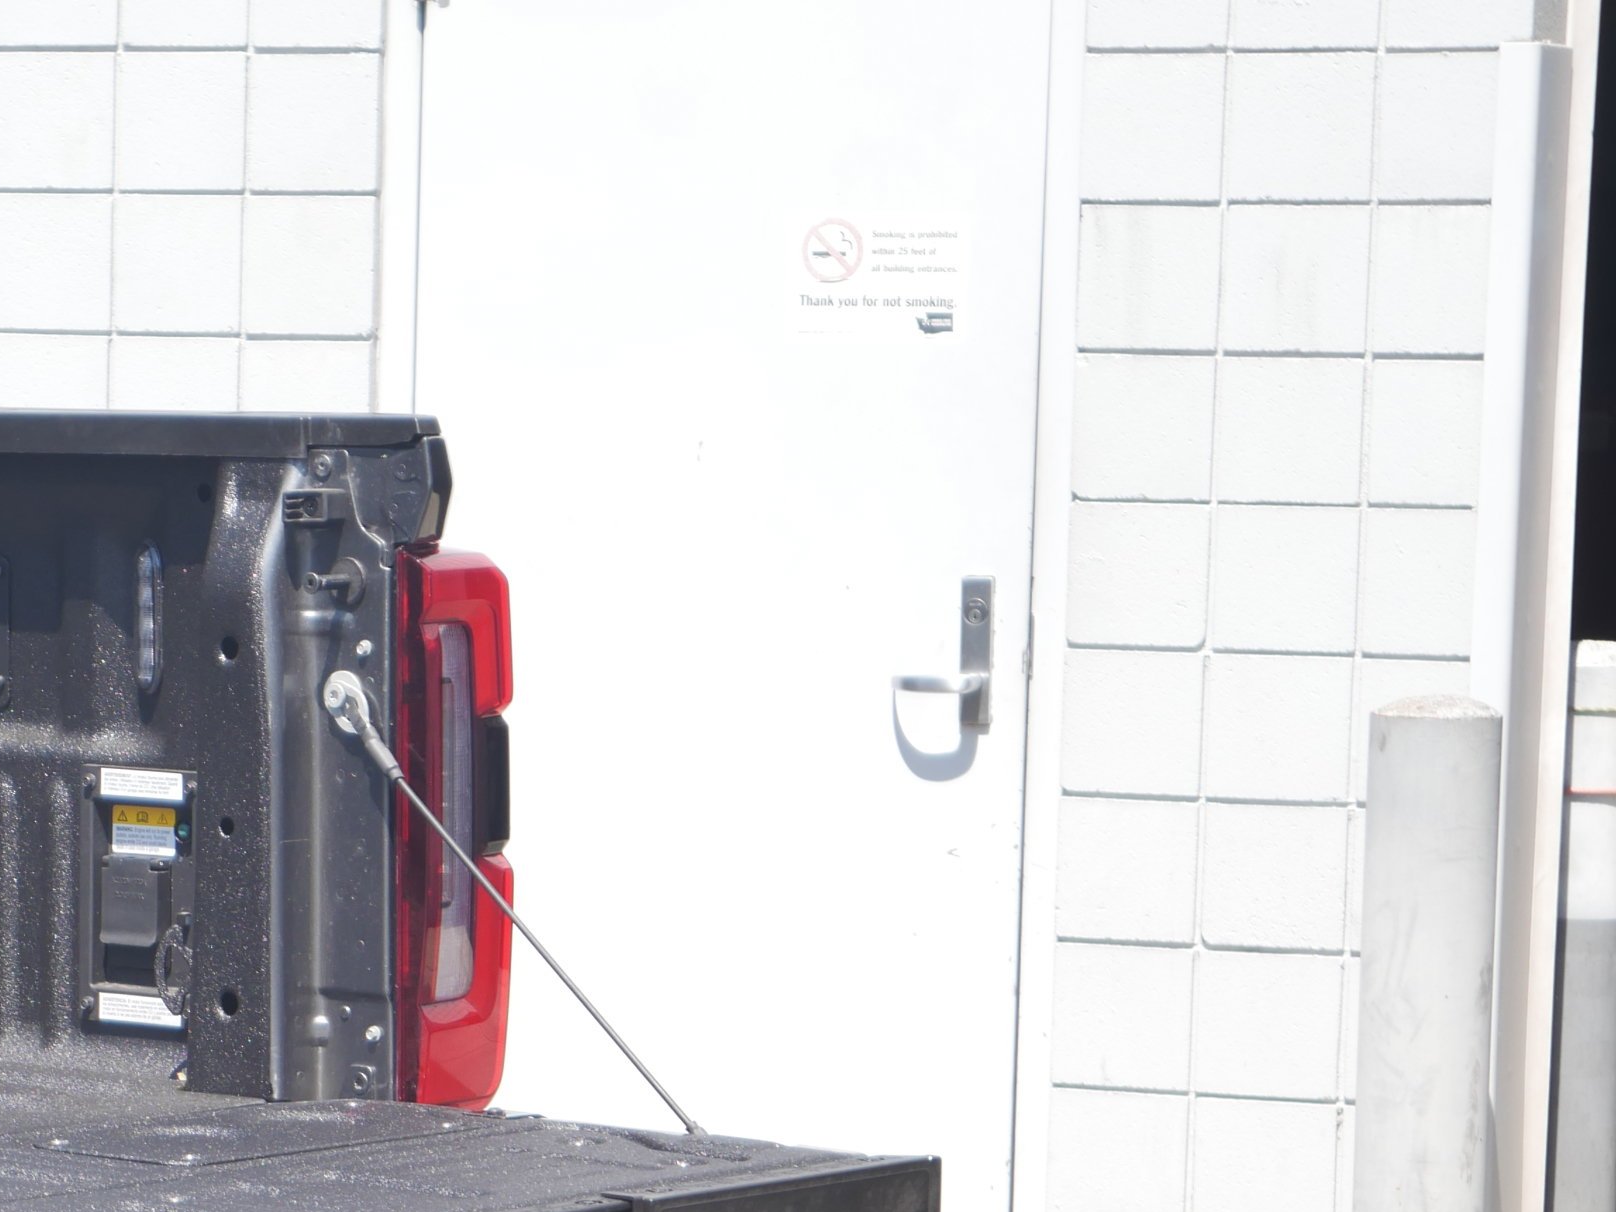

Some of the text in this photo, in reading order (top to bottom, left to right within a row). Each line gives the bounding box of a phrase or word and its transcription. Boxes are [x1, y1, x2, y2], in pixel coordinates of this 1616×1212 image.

[872, 230, 906, 240] Smoking
[917, 230, 958, 240] prohibited
[871, 247, 895, 255] within
[897, 247, 909, 255] 25
[911, 247, 926, 256] feet
[871, 264, 881, 273] all
[882, 264, 915, 274] building
[799, 294, 957, 310] Thank you for not smoking.
